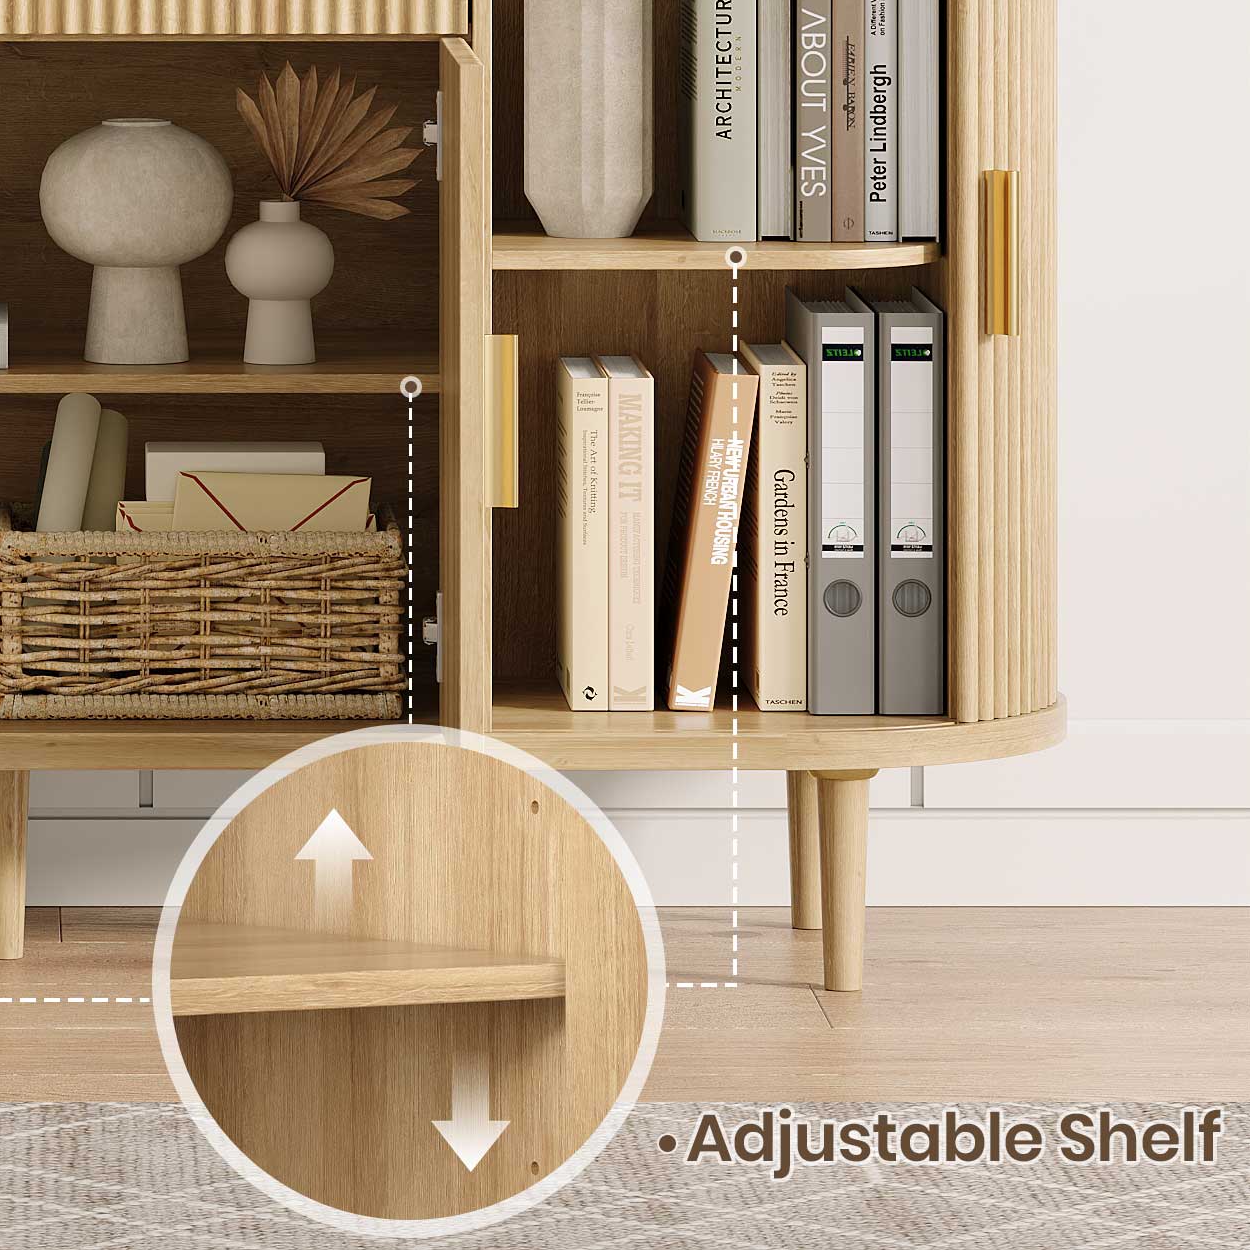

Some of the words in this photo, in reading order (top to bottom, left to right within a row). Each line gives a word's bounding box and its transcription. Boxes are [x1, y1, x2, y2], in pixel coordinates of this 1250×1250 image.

[878, 4, 886, 27] Fashion
[880, 27, 886, 36] on
[801, 8, 827, 113] ABOUT
[869, 64, 892, 153] Lindbergh
[801, 125, 827, 197] YVES
[869, 157, 887, 203] Peter
[590, 429, 598, 445] The
[618, 393, 643, 476] MAKING
[590, 448, 598, 463] Art
[590, 467, 598, 476] of
[707, 438, 725, 469] HILARY
[587, 477, 598, 514] Knitting
[618, 481, 643, 502] IT
[703, 470, 721, 506] FRENCH
[773, 469, 796, 536] Gardens
[710, 511, 734, 565] HOUSING
[773, 539, 796, 556] in
[773, 561, 796, 617] France
